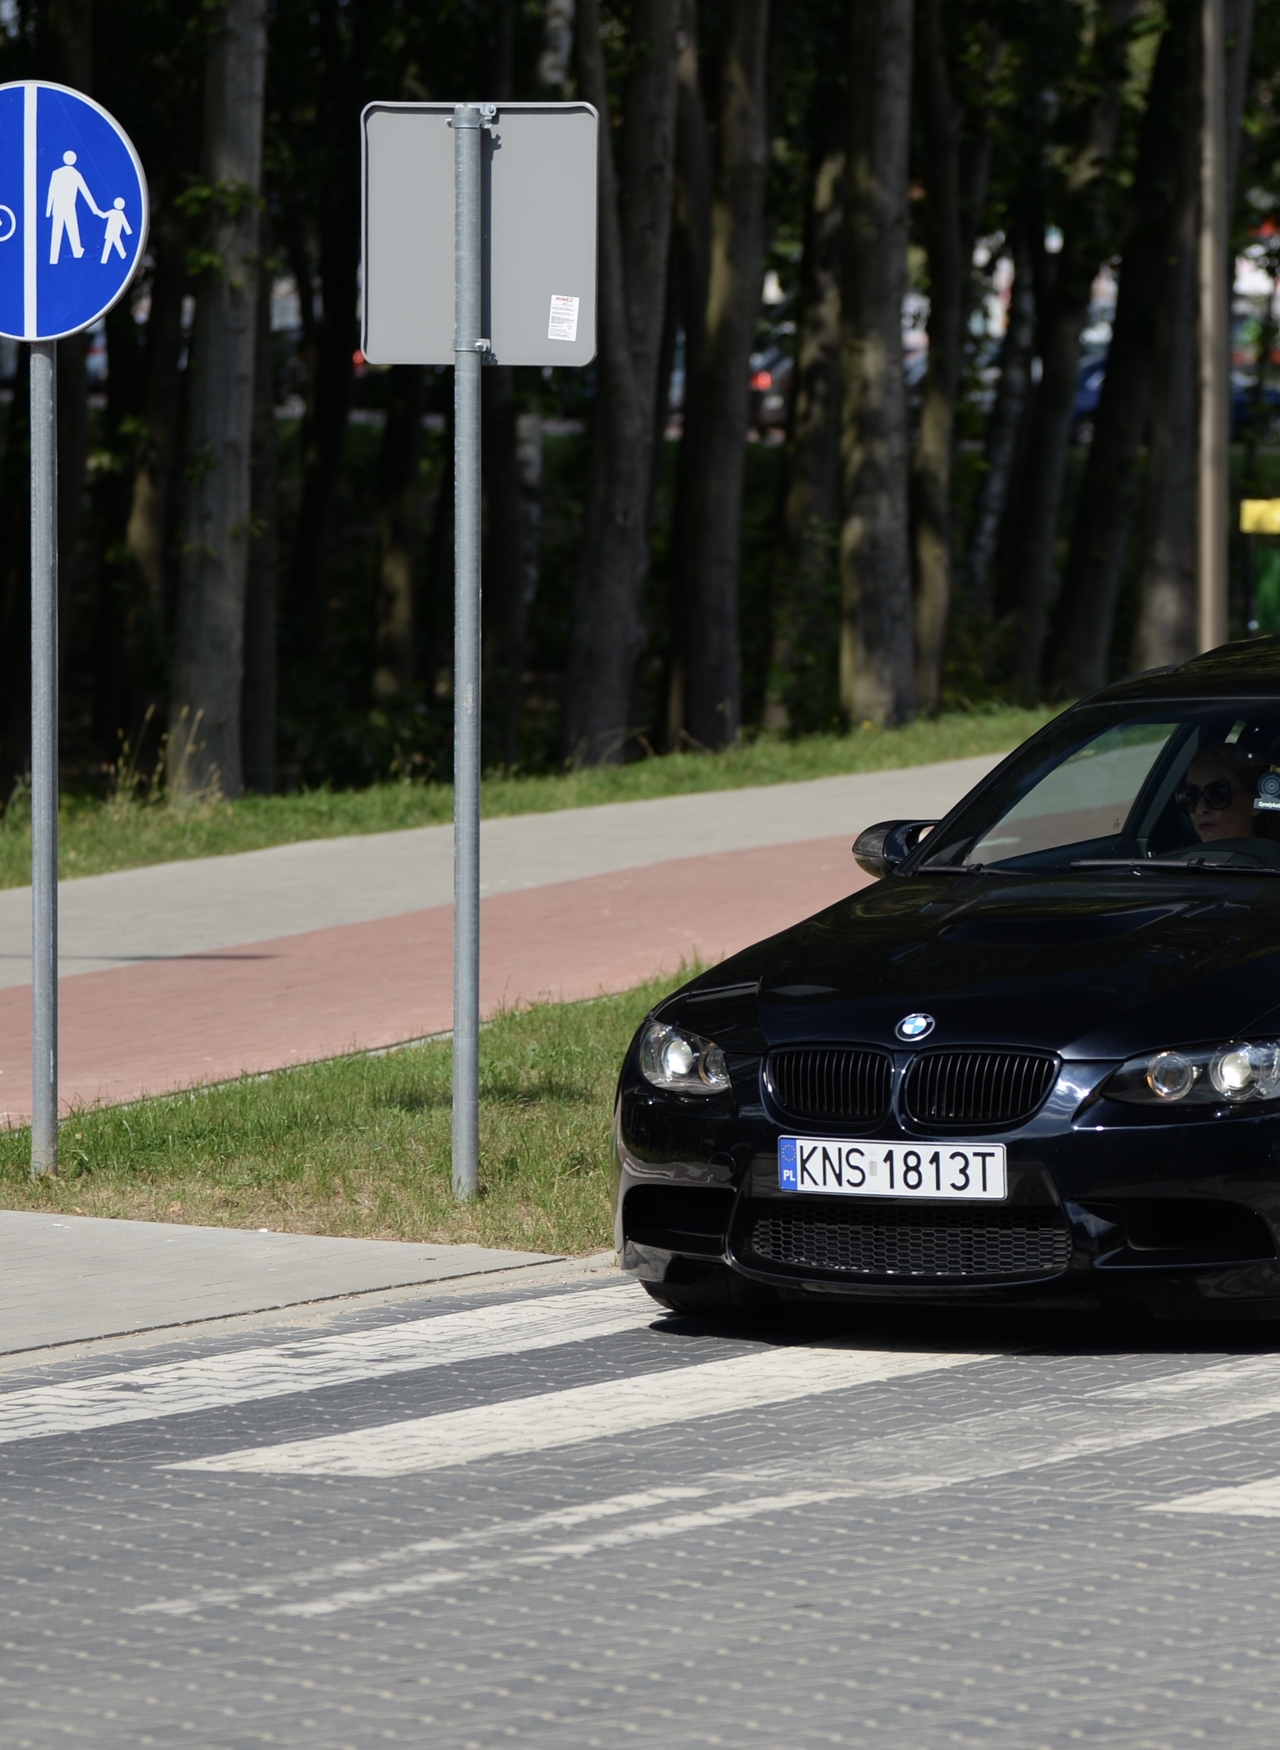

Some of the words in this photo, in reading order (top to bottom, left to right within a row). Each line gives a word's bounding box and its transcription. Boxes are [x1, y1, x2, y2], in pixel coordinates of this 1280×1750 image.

[783, 1169, 796, 1181] PL
[799, 1145, 866, 1188] KNS
[882, 1149, 995, 1192] 1813T
